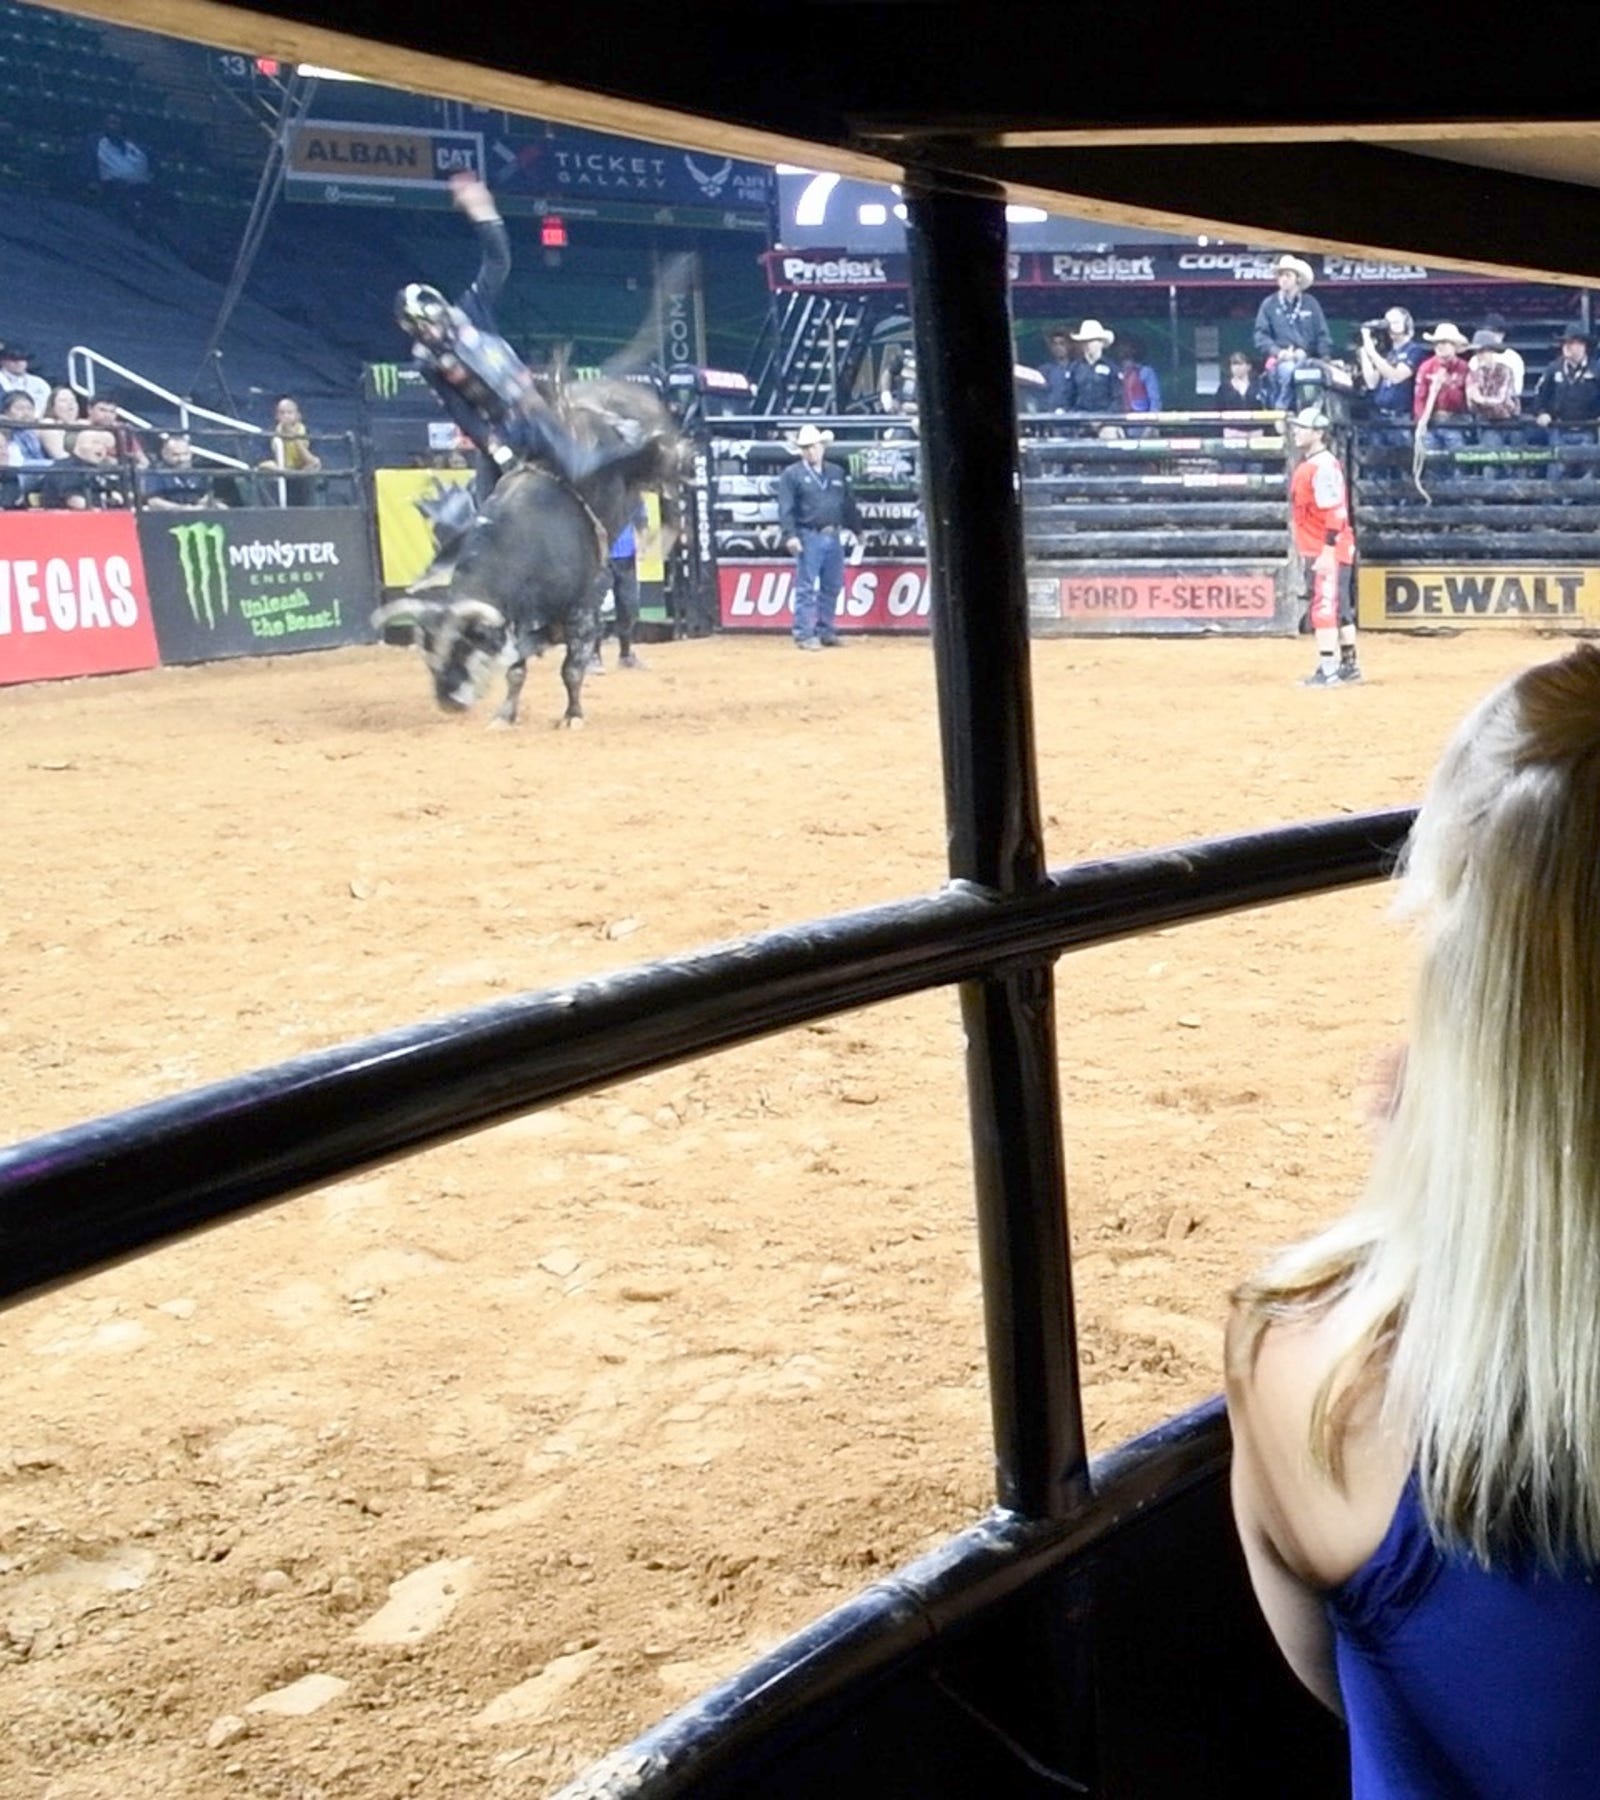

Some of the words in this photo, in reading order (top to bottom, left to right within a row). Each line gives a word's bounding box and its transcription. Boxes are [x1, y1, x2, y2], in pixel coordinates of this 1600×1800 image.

[307, 139, 418, 167] ALBAN
[436, 148, 475, 171] CAT
[554, 151, 666, 174] TICKET
[557, 172, 667, 188] GALAXY
[783, 257, 885, 280] Priefert
[1052, 254, 1155, 276] Priefert
[1232, 268, 1276, 280] TIRE
[229, 540, 340, 570] MONSTER
[250, 570, 325, 585] ENERGY
[240, 588, 311, 619] Unleash
[730, 571, 879, 617] LUS
[1066, 585, 1138, 611] FORD
[1149, 585, 1267, 611] F-SERIES
[252, 615, 286, 638] the
